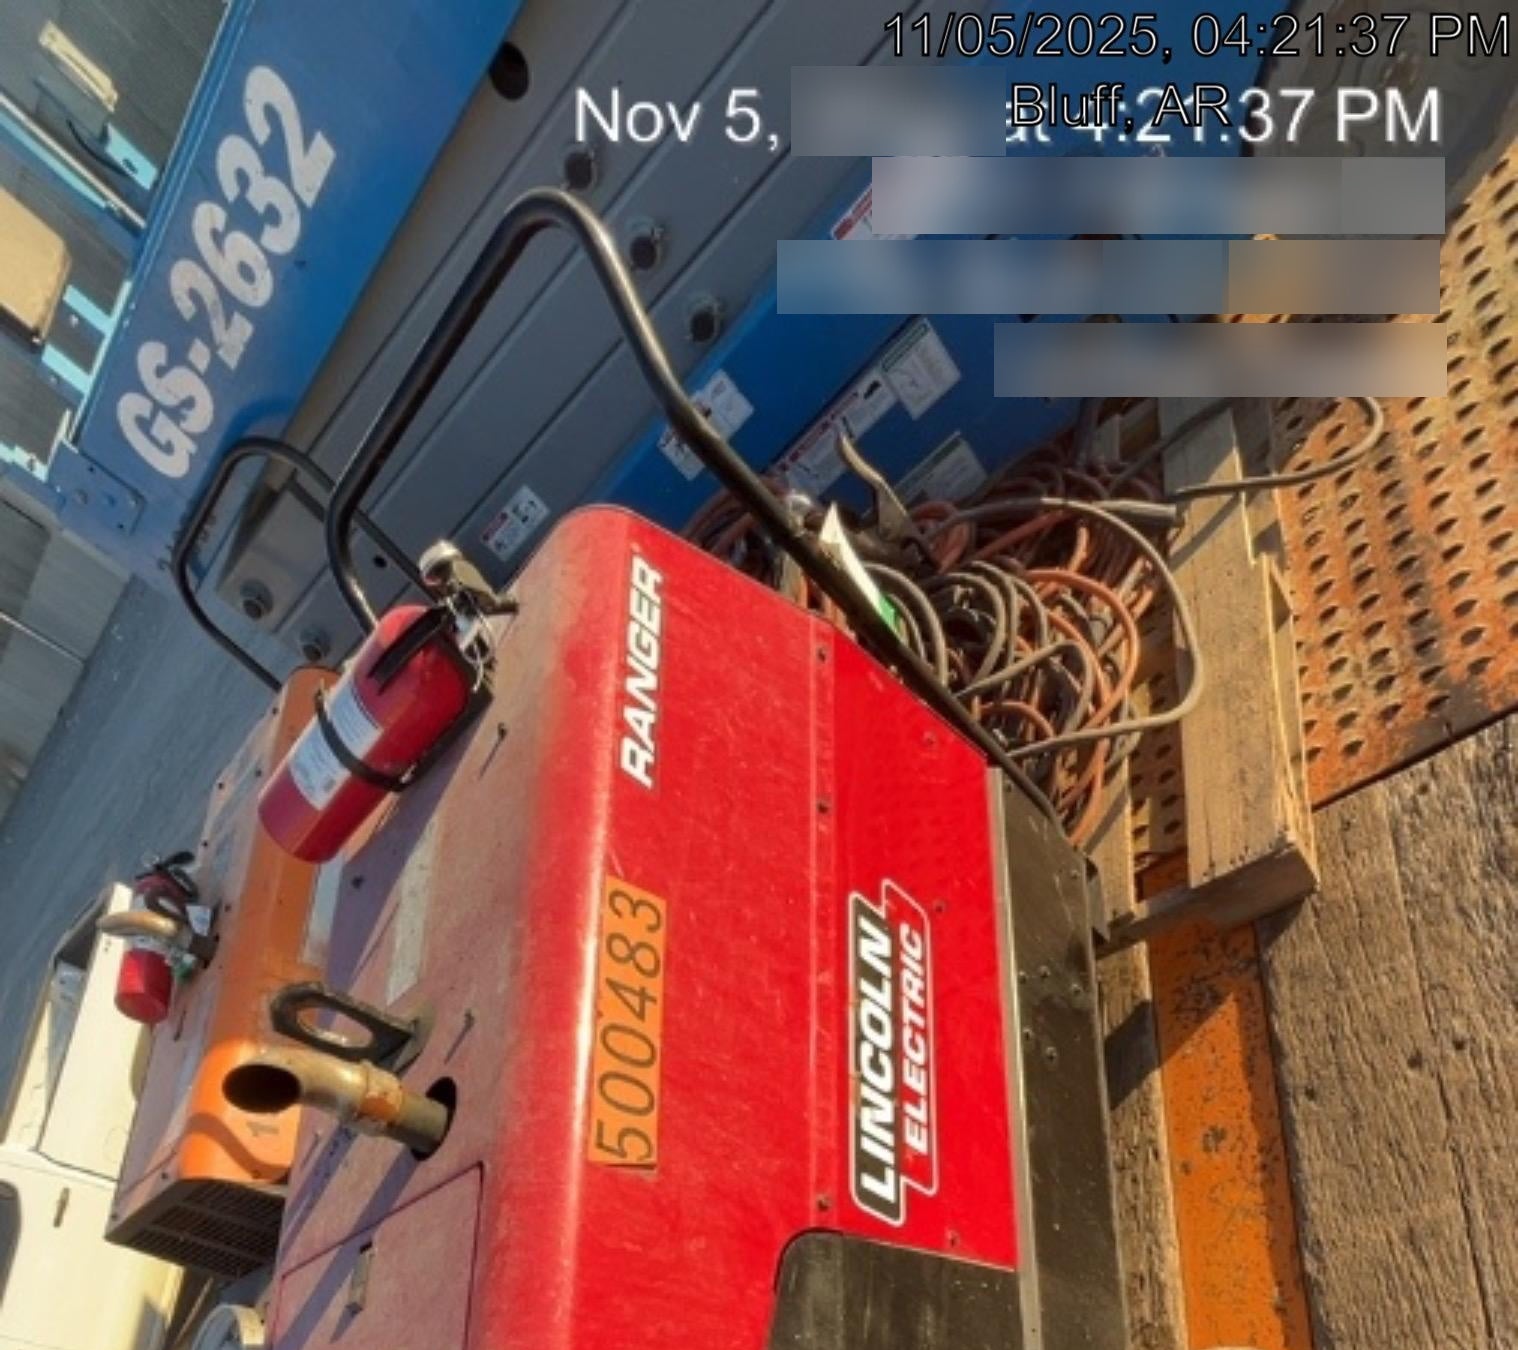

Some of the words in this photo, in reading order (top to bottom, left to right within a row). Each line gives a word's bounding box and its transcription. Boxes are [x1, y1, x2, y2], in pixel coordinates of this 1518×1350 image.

[116, 65, 336, 479] GS-2632
[619, 555, 664, 789] RANGER
[595, 889, 662, 1161] 500483
[857, 916, 896, 1203] LINCOLN
[899, 922, 929, 1156] ELECTRIC
